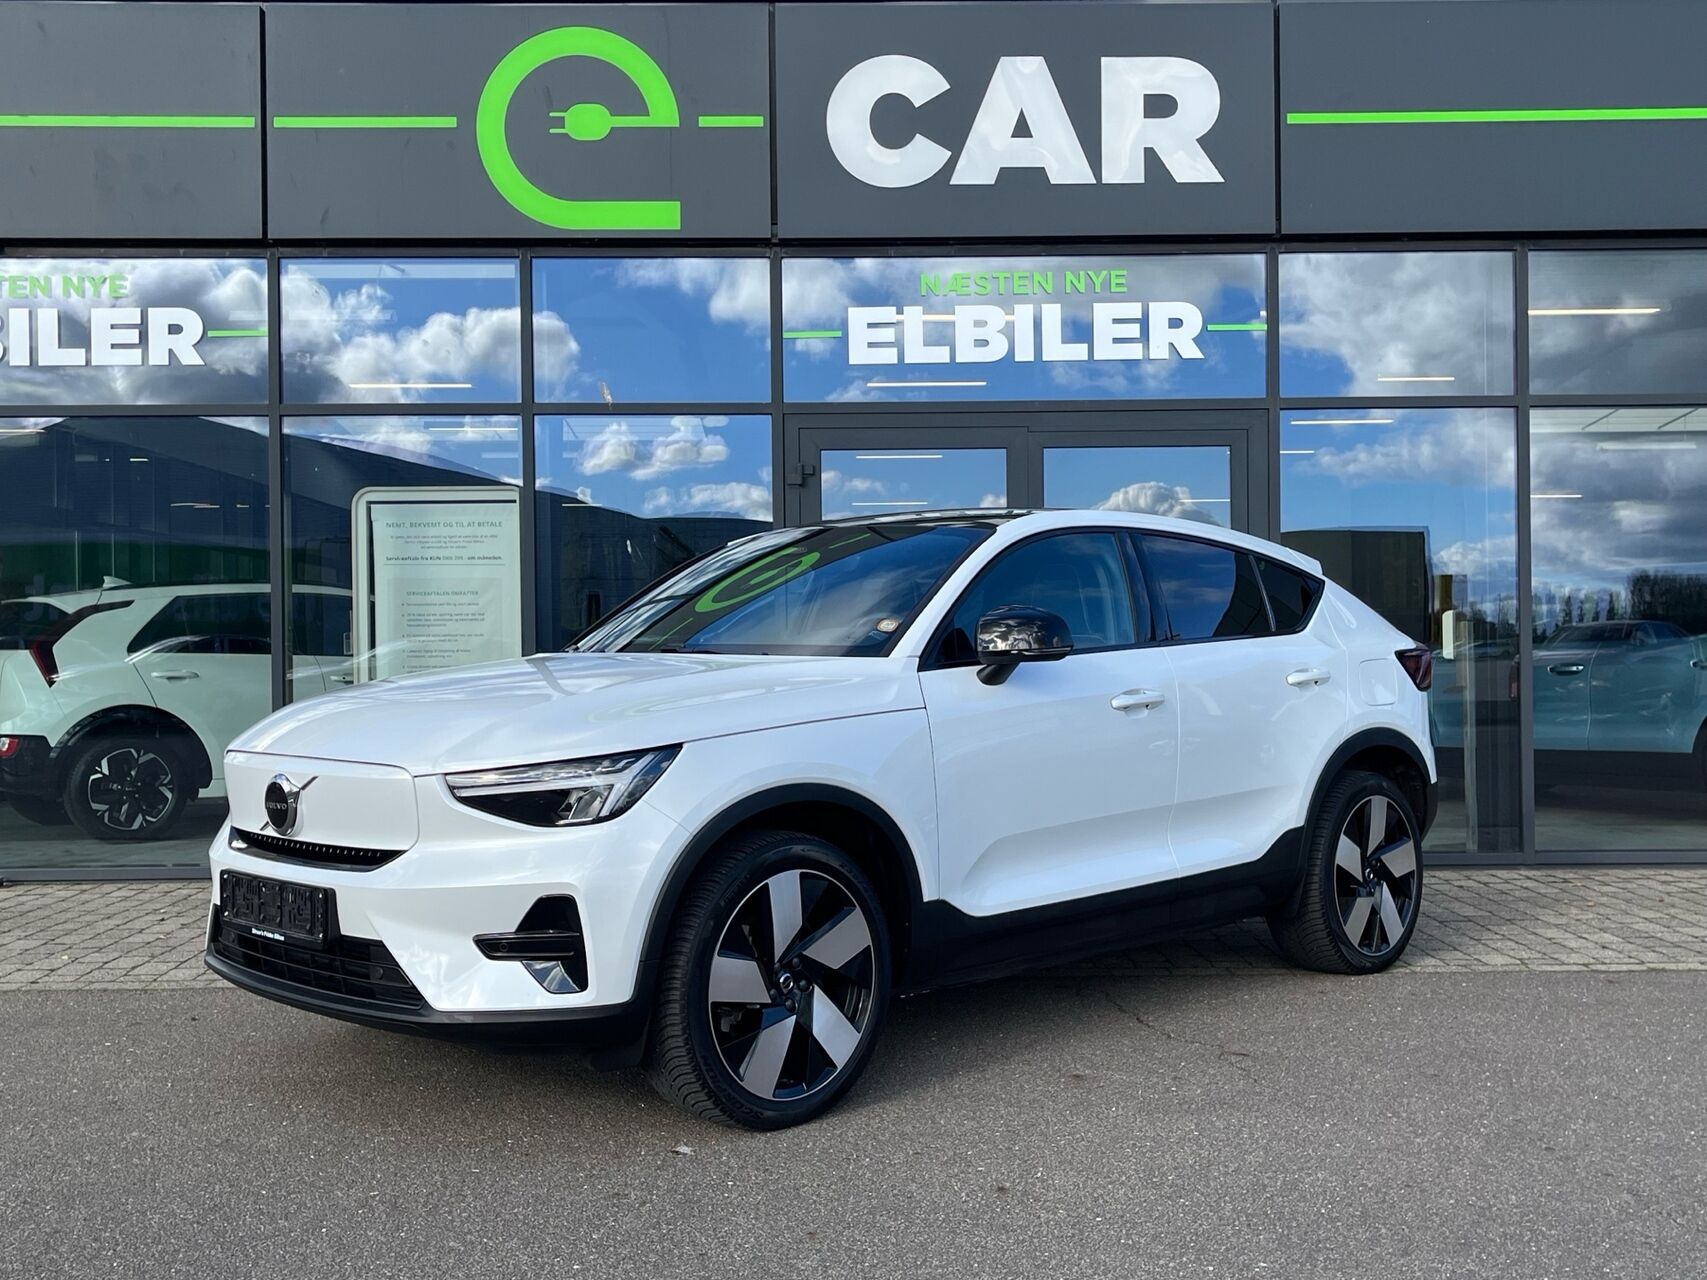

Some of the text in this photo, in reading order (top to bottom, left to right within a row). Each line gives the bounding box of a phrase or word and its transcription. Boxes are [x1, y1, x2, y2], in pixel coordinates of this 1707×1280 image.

[826, 54, 1226, 189] CAR
[62, 275, 128, 298] NYE
[920, 269, 1128, 296] NÆSTEN NYE
[0, 307, 206, 367] ILER
[847, 301, 1205, 365] ELBILER
